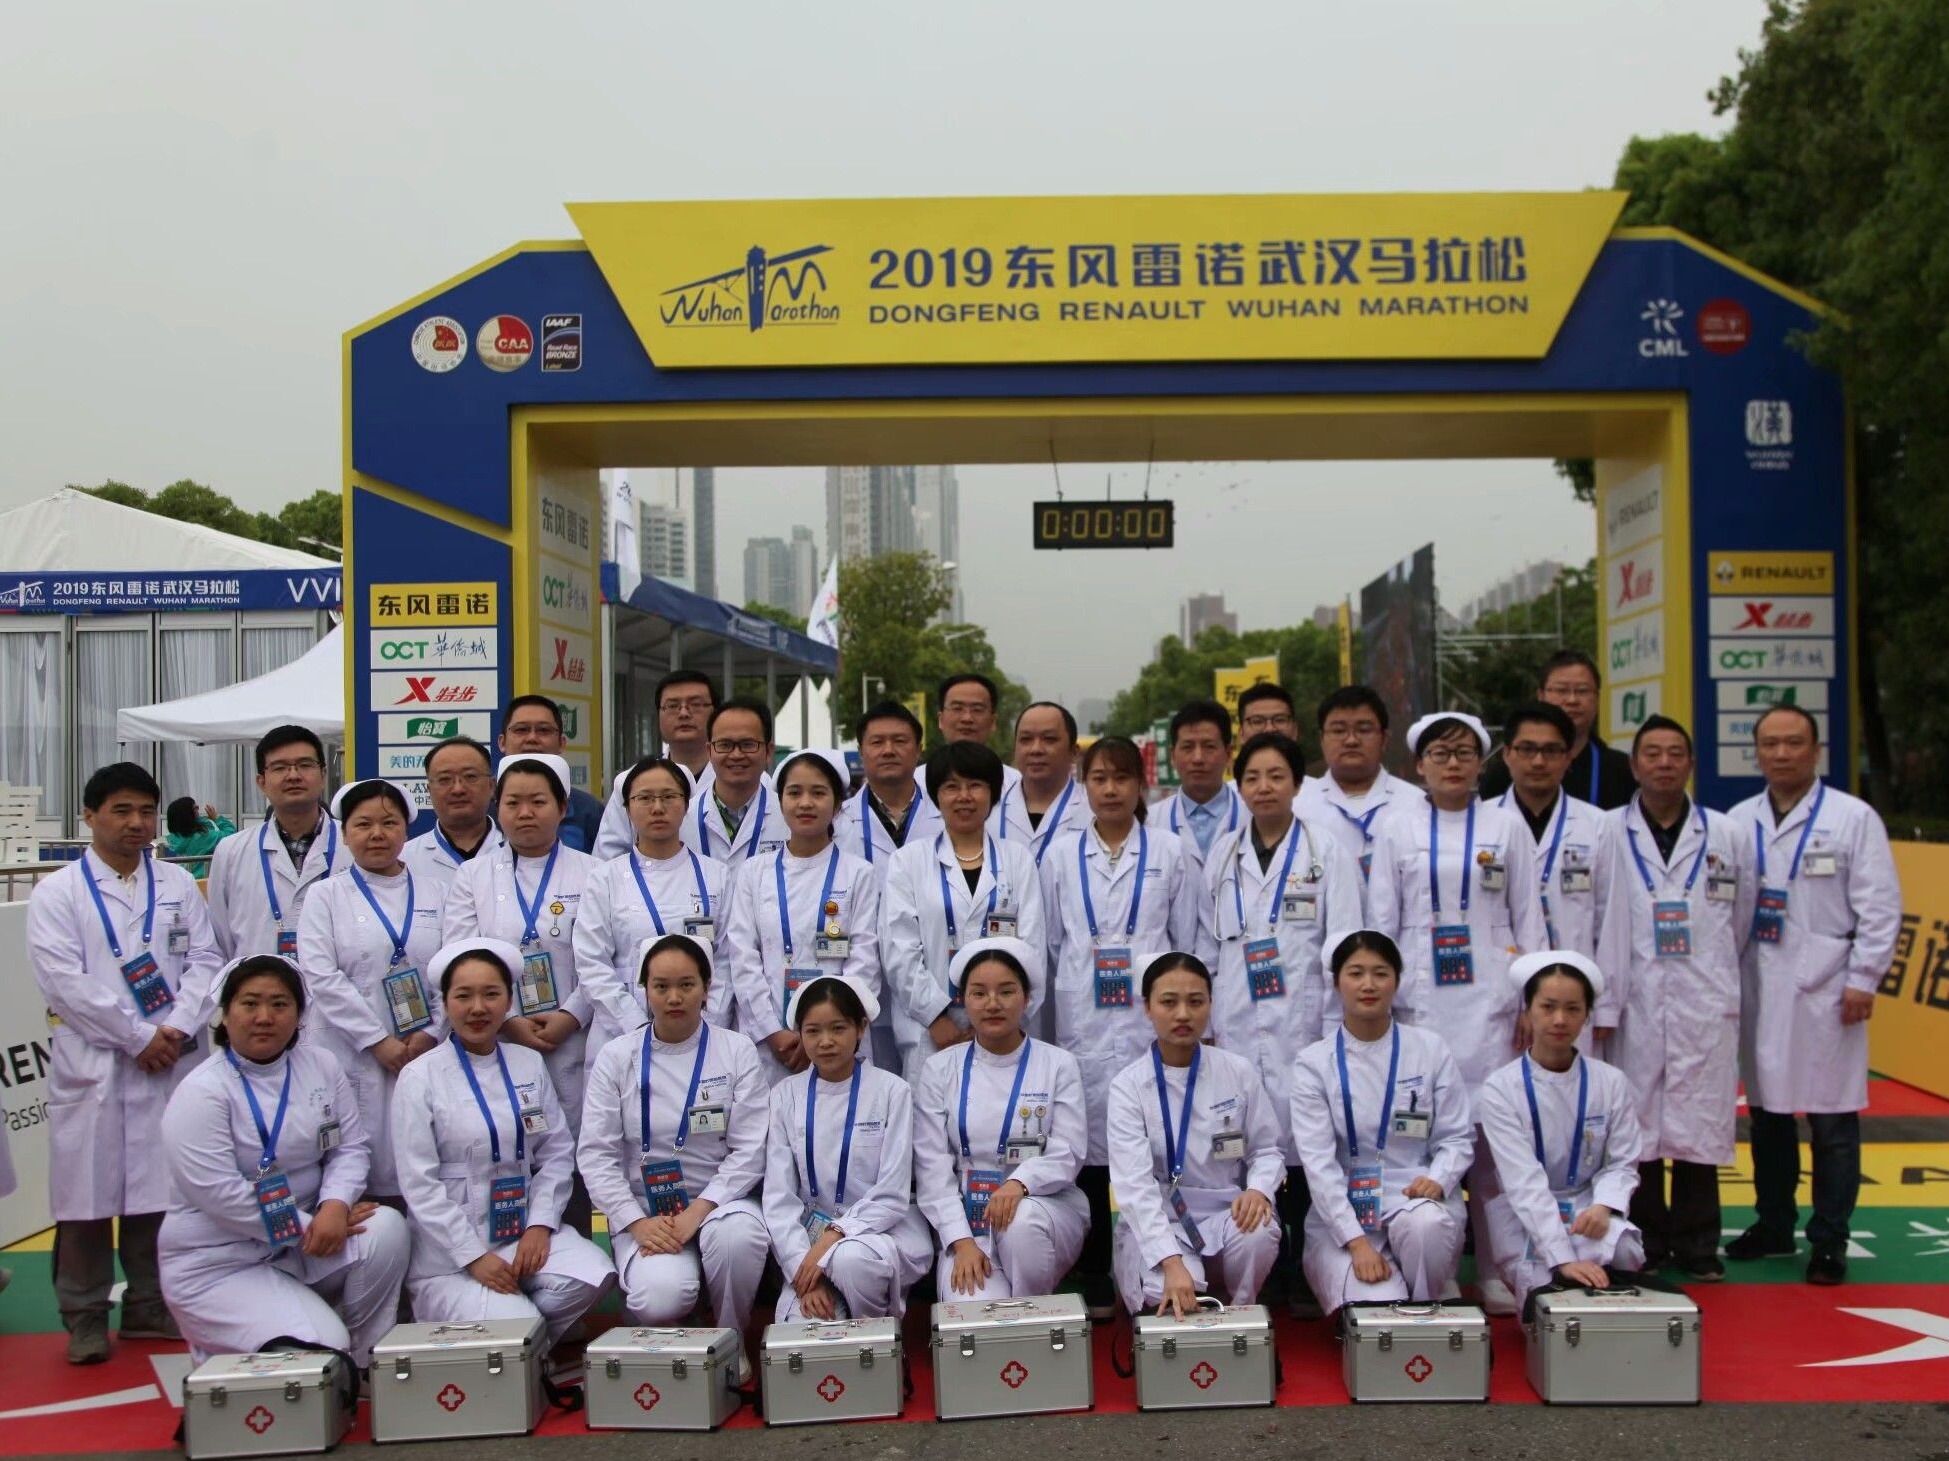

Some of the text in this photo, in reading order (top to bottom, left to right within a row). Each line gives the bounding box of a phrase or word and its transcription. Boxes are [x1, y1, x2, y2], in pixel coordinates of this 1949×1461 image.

[869, 237, 1527, 289] 2019东风雷诺武汉马拉松
[869, 295, 1530, 324] DONGFENG RENAULT WUHAN MARATHON
[498, 338, 530, 350] CAA
[1638, 338, 1690, 358] CML
[541, 497, 589, 550] 东风雷诺
[1042, 509, 1165, 539] 0:00:00
[1741, 564, 1826, 581] RENAULT
[53, 579, 240, 597] 2019东风雷诺武汉马拉松
[543, 574, 567, 609] OCT
[53, 596, 240, 606] DONGFENG RENAULT WUHAN MARATHON
[378, 593, 489, 616] 东风雷诺
[380, 641, 429, 660] OCT
[1719, 650, 1768, 670] OCT
[433, 685, 478, 703] 特步
